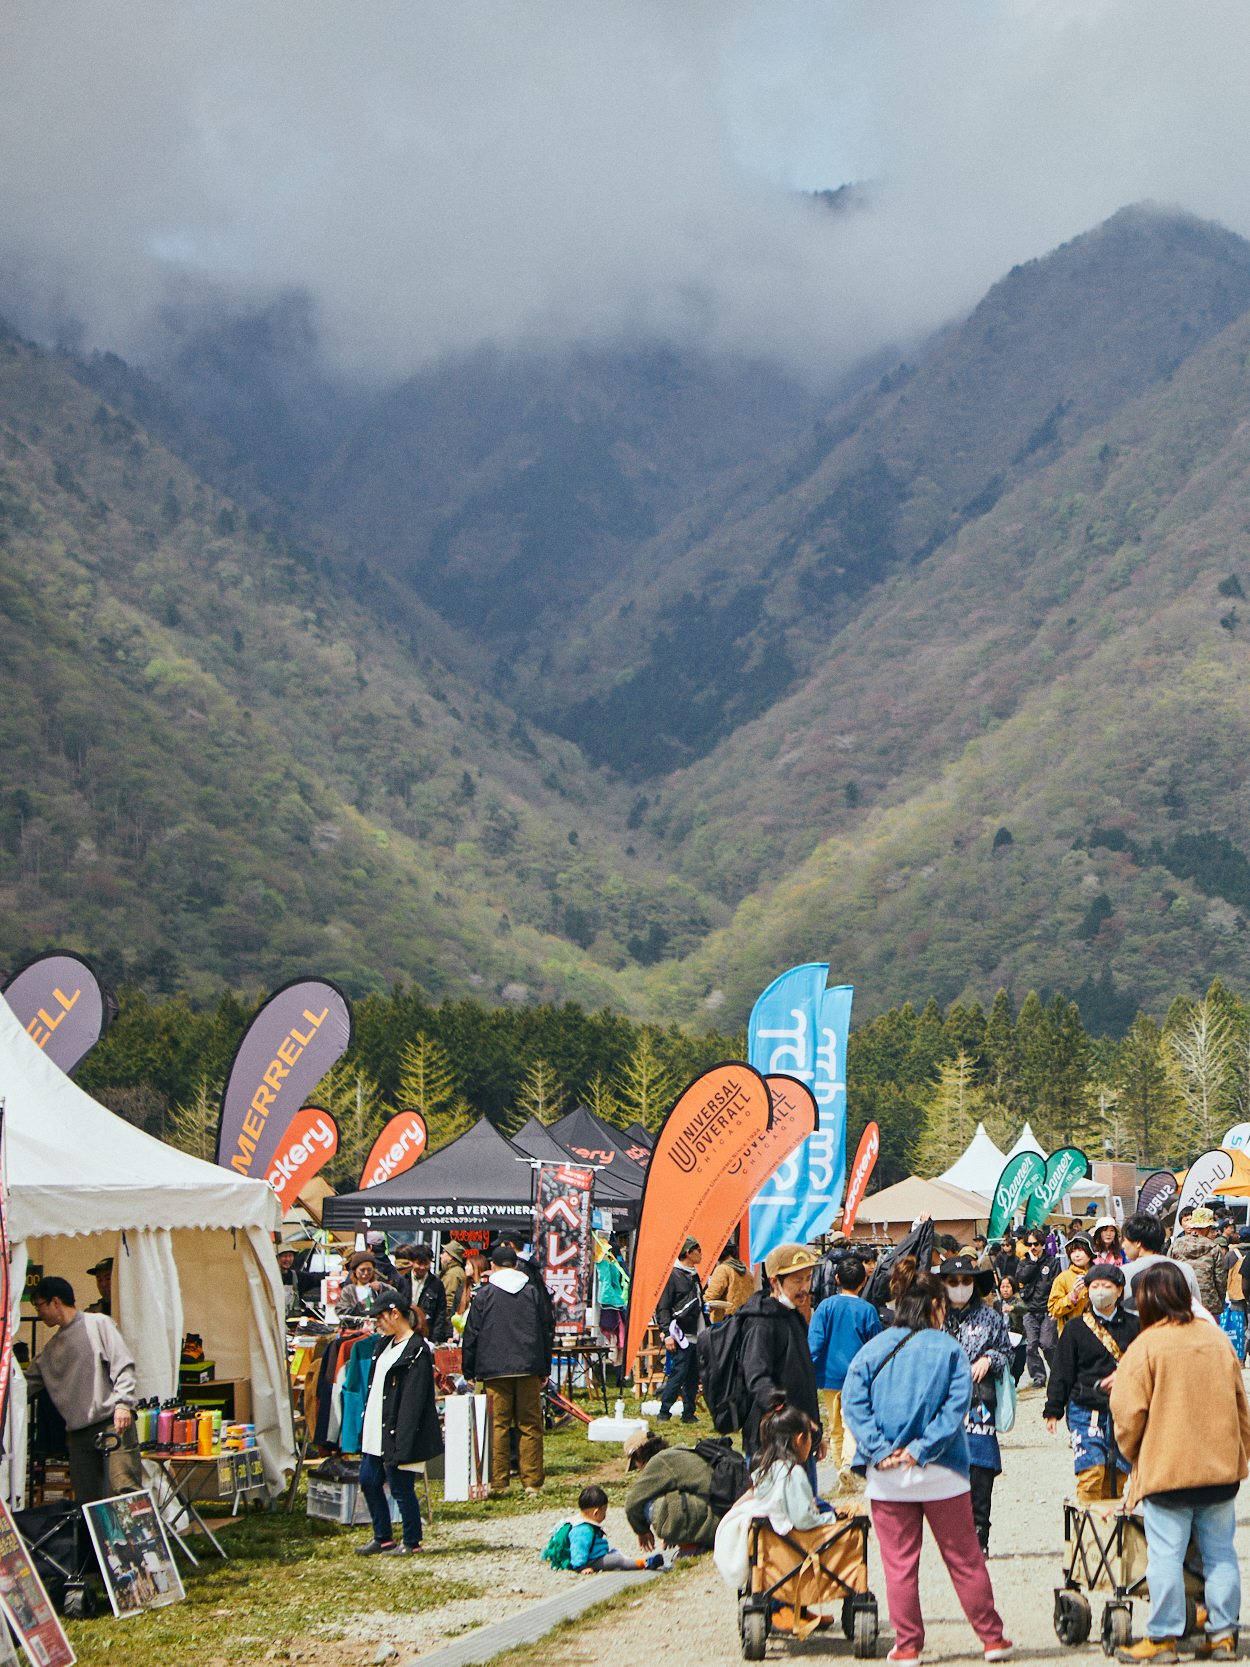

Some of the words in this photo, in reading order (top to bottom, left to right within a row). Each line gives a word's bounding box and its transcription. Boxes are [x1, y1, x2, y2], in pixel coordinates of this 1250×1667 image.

[26, 988, 81, 1049] ELL
[231, 1007, 329, 1176] MERRELL
[567, 1144, 616, 1164] ery
[668, 1079, 740, 1173] UNIVERSAL
[695, 1093, 751, 1154] OVERALL
[697, 1110, 751, 1174] CHICAGO
[742, 1116, 795, 1175] CHICAGO
[748, 1127, 761, 1142] 1924
[268, 1118, 334, 1192] ckery
[366, 1120, 424, 1189] ckery
[843, 1130, 878, 1225] Jackery
[1034, 1151, 1073, 1209] Danner
[364, 1206, 426, 1216] BLANKETS
[429, 1205, 453, 1215] FOR
[996, 1156, 1033, 1219] Danner
[1186, 1164, 1227, 1208] ash-U
[543, 1194, 581, 1305] ペレ炭
[965, 1424, 997, 1436] TAFF
